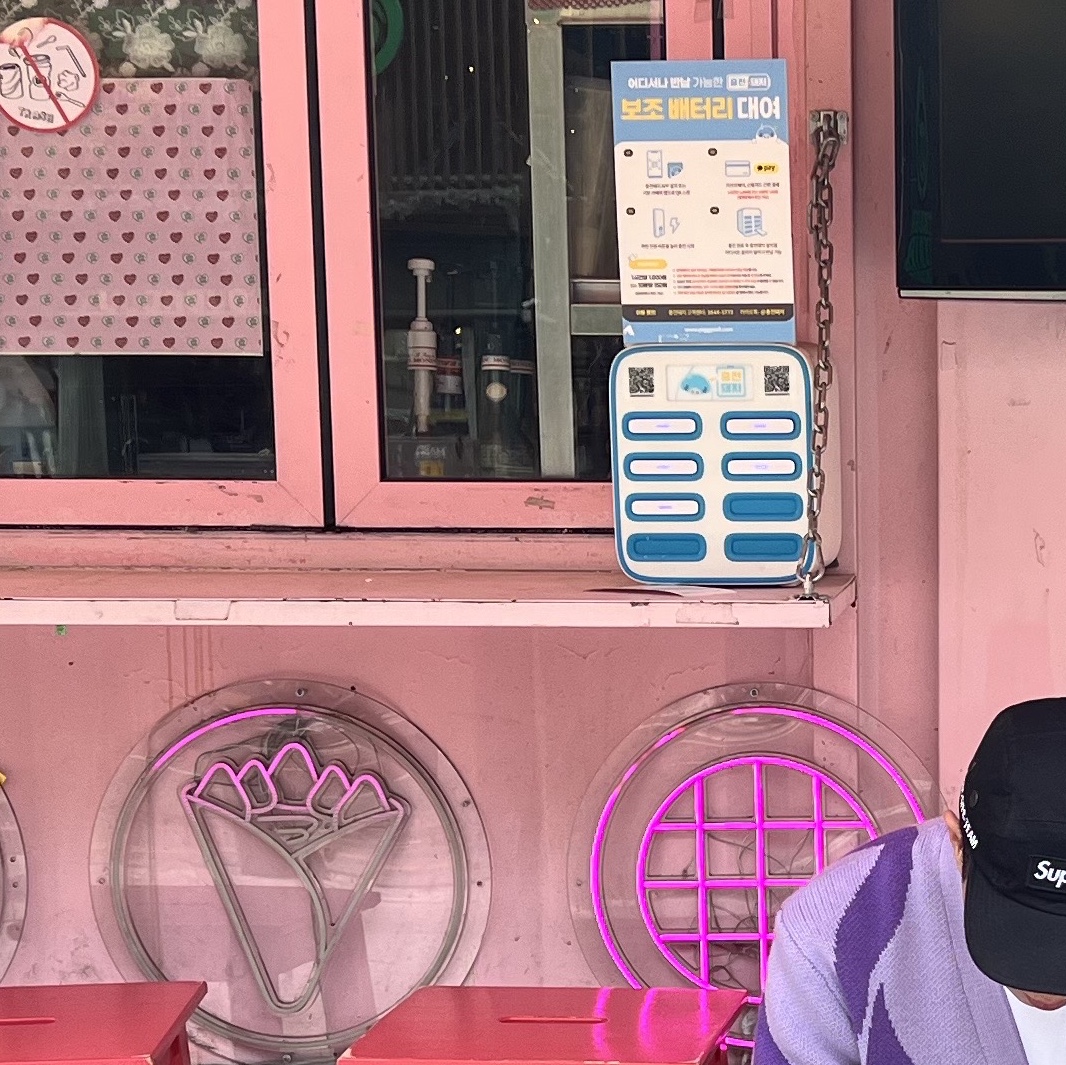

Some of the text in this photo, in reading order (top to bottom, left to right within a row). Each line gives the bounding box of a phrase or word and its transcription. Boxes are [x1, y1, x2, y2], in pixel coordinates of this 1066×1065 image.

[627, 76, 668, 89] 어디서나
[620, 96, 781, 121] 보조 배터리 대여
